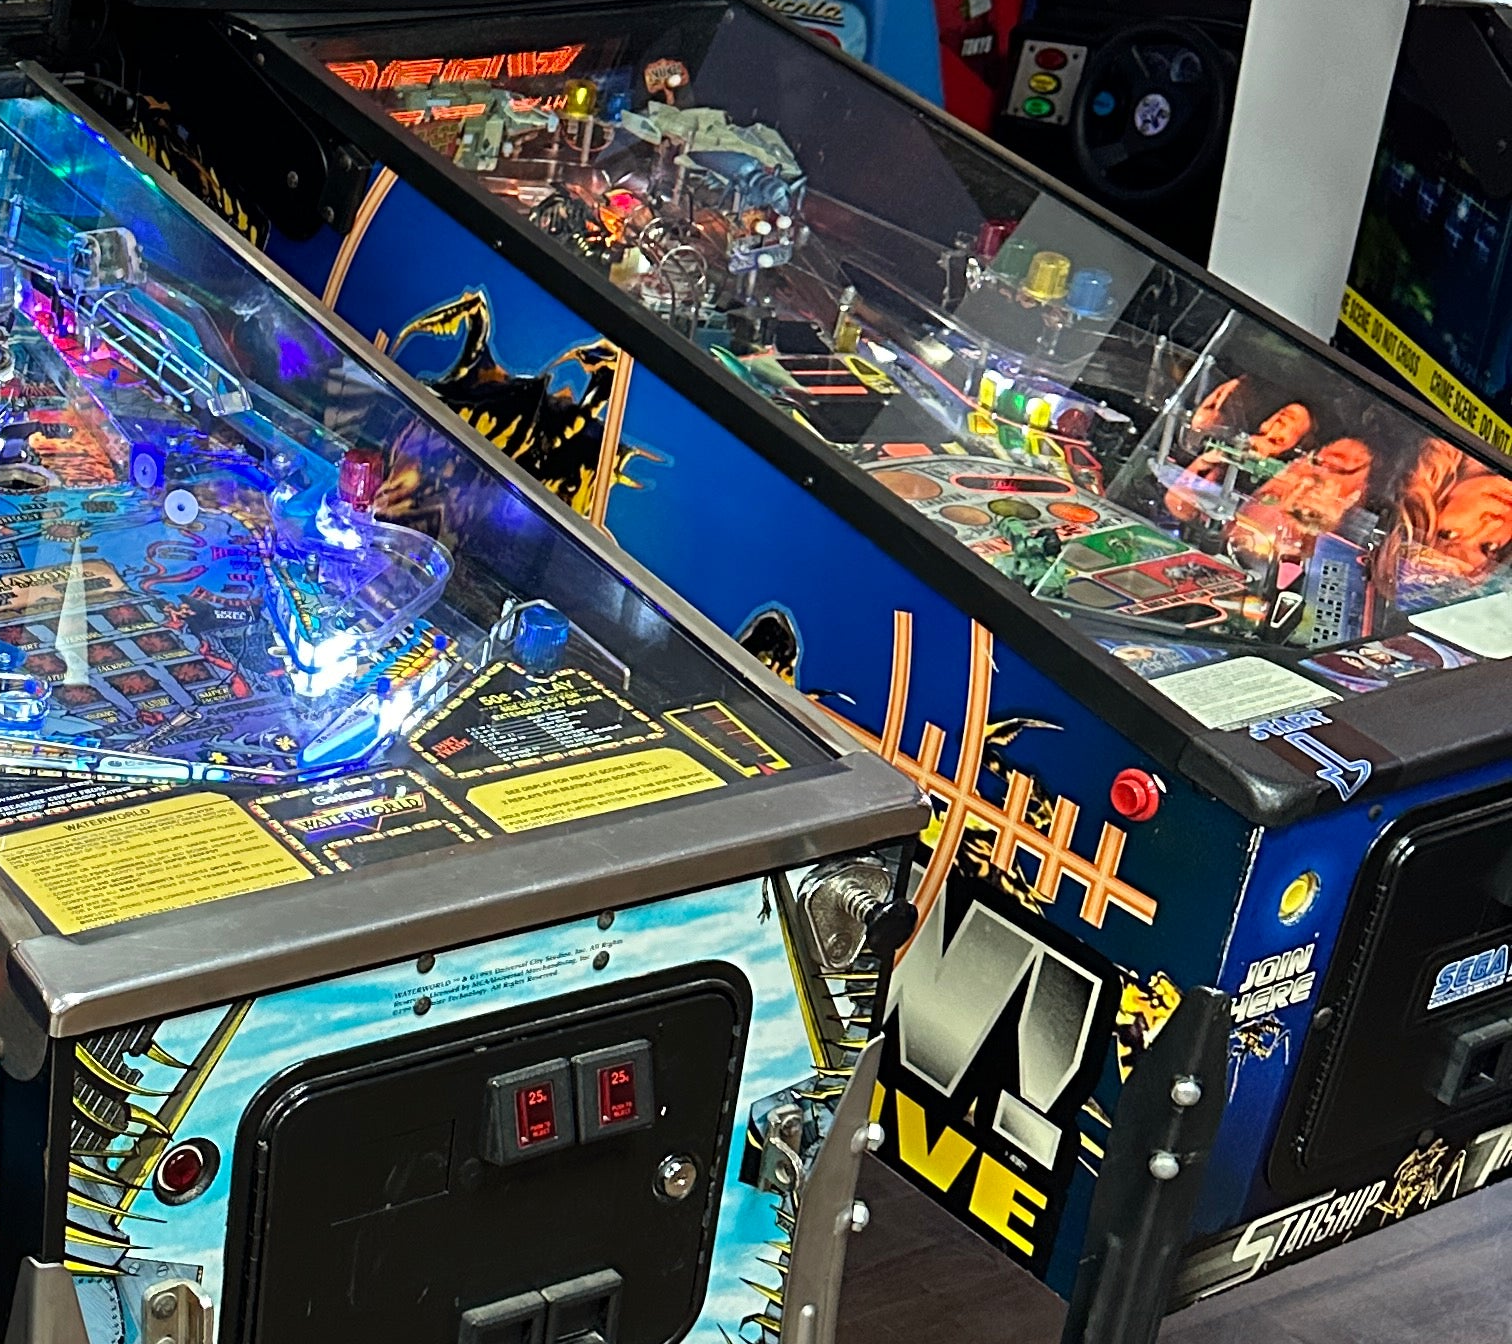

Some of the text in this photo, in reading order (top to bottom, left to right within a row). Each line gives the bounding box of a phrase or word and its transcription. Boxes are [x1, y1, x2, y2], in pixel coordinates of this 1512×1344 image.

[1349, 298, 1372, 334] SCENE
[1371, 318, 1384, 344] DO
[1384, 327, 1399, 358] NOT
[1396, 339, 1421, 377] CROSS
[1430, 370, 1455, 409] CRIME
[1452, 390, 1479, 429] SCENE
[1479, 414, 1495, 442] DO
[1493, 423, 1511, 455] NOT
[526, 679, 575, 697] PLAY
[1247, 709, 1333, 742] START
[63, 807, 151, 833] WATERWORLD
[300, 797, 420, 832] WATERWORLD
[394, 980, 452, 1000] WATERWORLD
[1239, 943, 1315, 994] JOIN
[1434, 944, 1509, 996] SEGA
[1230, 971, 1316, 1024] HERE
[1199, 1179, 1387, 1299] STARSHIP
